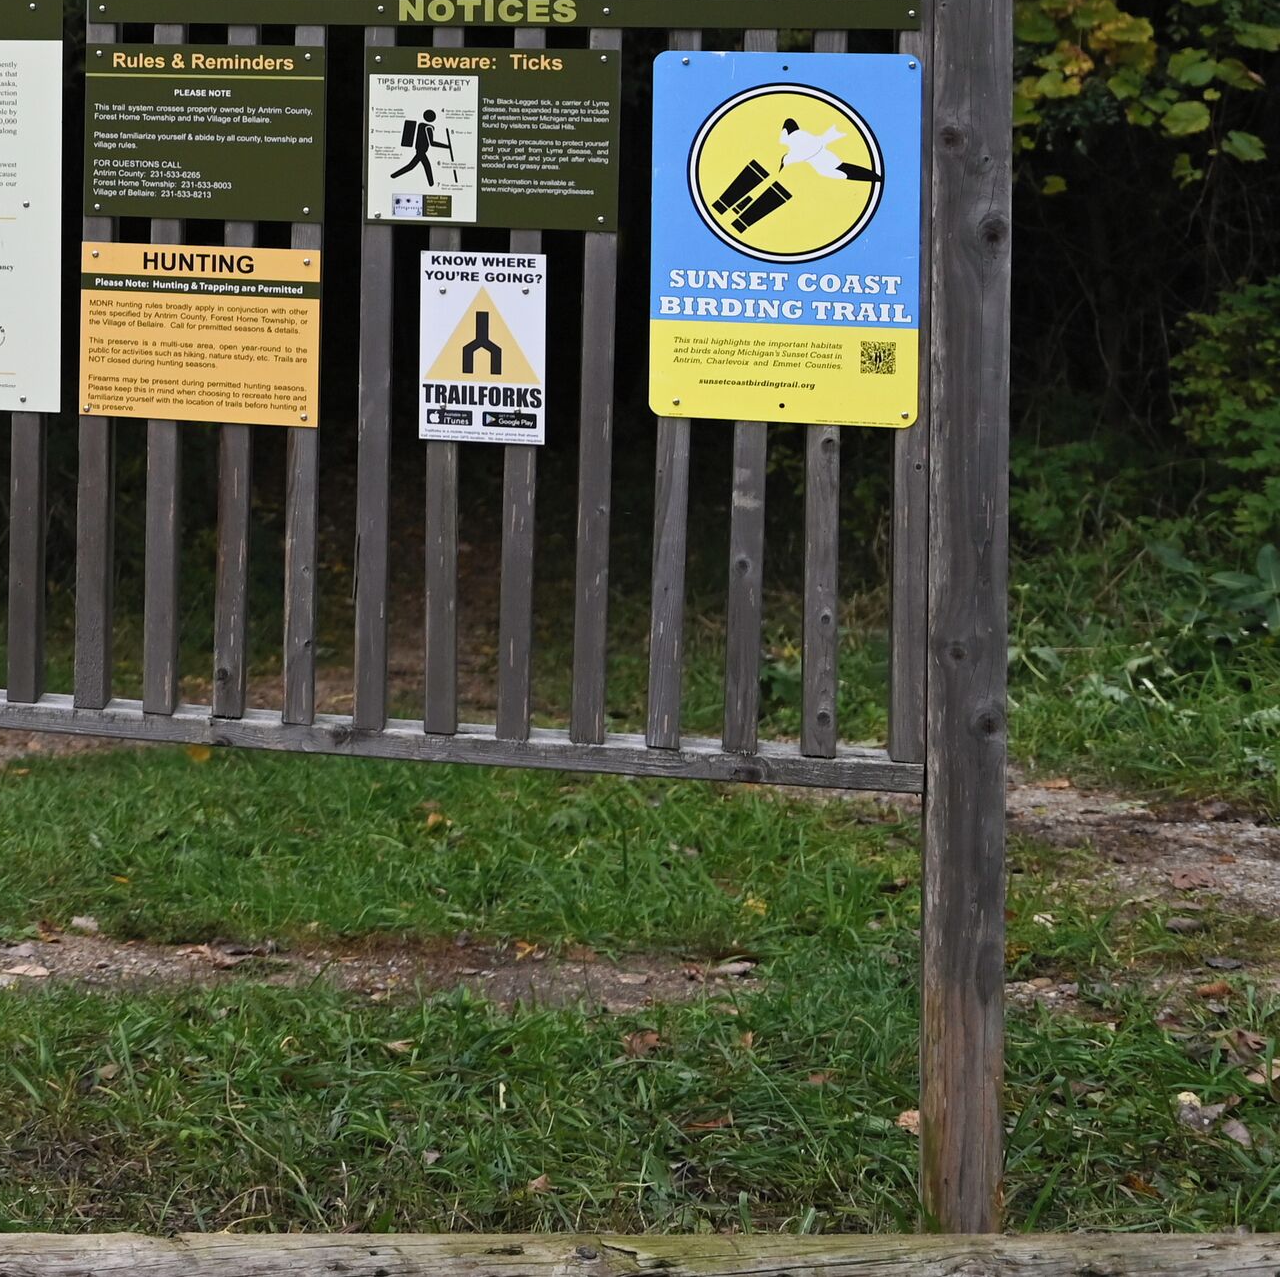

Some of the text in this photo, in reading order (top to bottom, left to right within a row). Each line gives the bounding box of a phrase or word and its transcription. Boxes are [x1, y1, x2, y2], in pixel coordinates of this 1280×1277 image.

[113, 52, 294, 70] Rules & Reminders
[417, 53, 563, 70] Beware: Ticks
[143, 252, 254, 274] HUNTING
[431, 255, 536, 268] KNOW WHERE
[484, 272, 543, 284] GOING?
[670, 269, 902, 295] SUNSET COAST
[660, 296, 912, 323] BIRDING TRAIL
[699, 379, 815, 391] sunsetcoastbirdingtrail.org
[422, 384, 543, 409] TRAILFORKS
